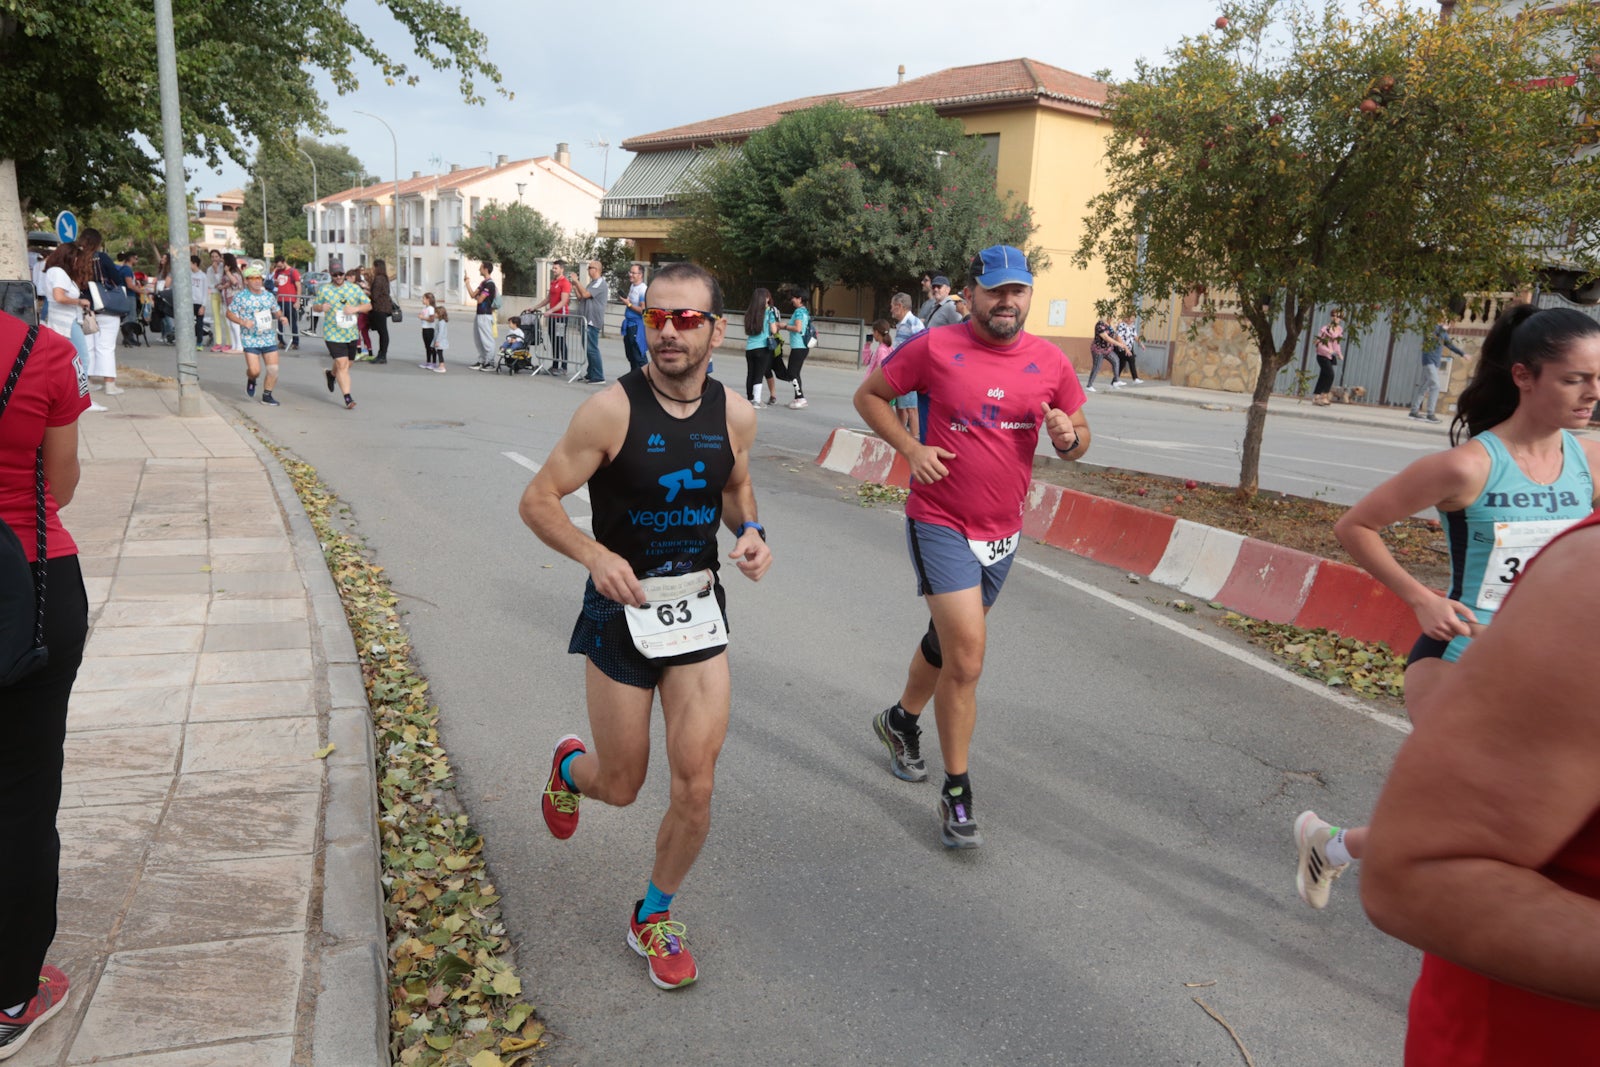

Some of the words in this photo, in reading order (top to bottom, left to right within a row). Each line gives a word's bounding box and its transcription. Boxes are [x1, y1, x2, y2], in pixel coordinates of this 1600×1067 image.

[987, 388, 1005, 401] edp
[950, 423, 969, 433] 21K
[1483, 486, 1580, 514] nerja
[986, 536, 1013, 561] 345
[656, 599, 692, 626] 63
